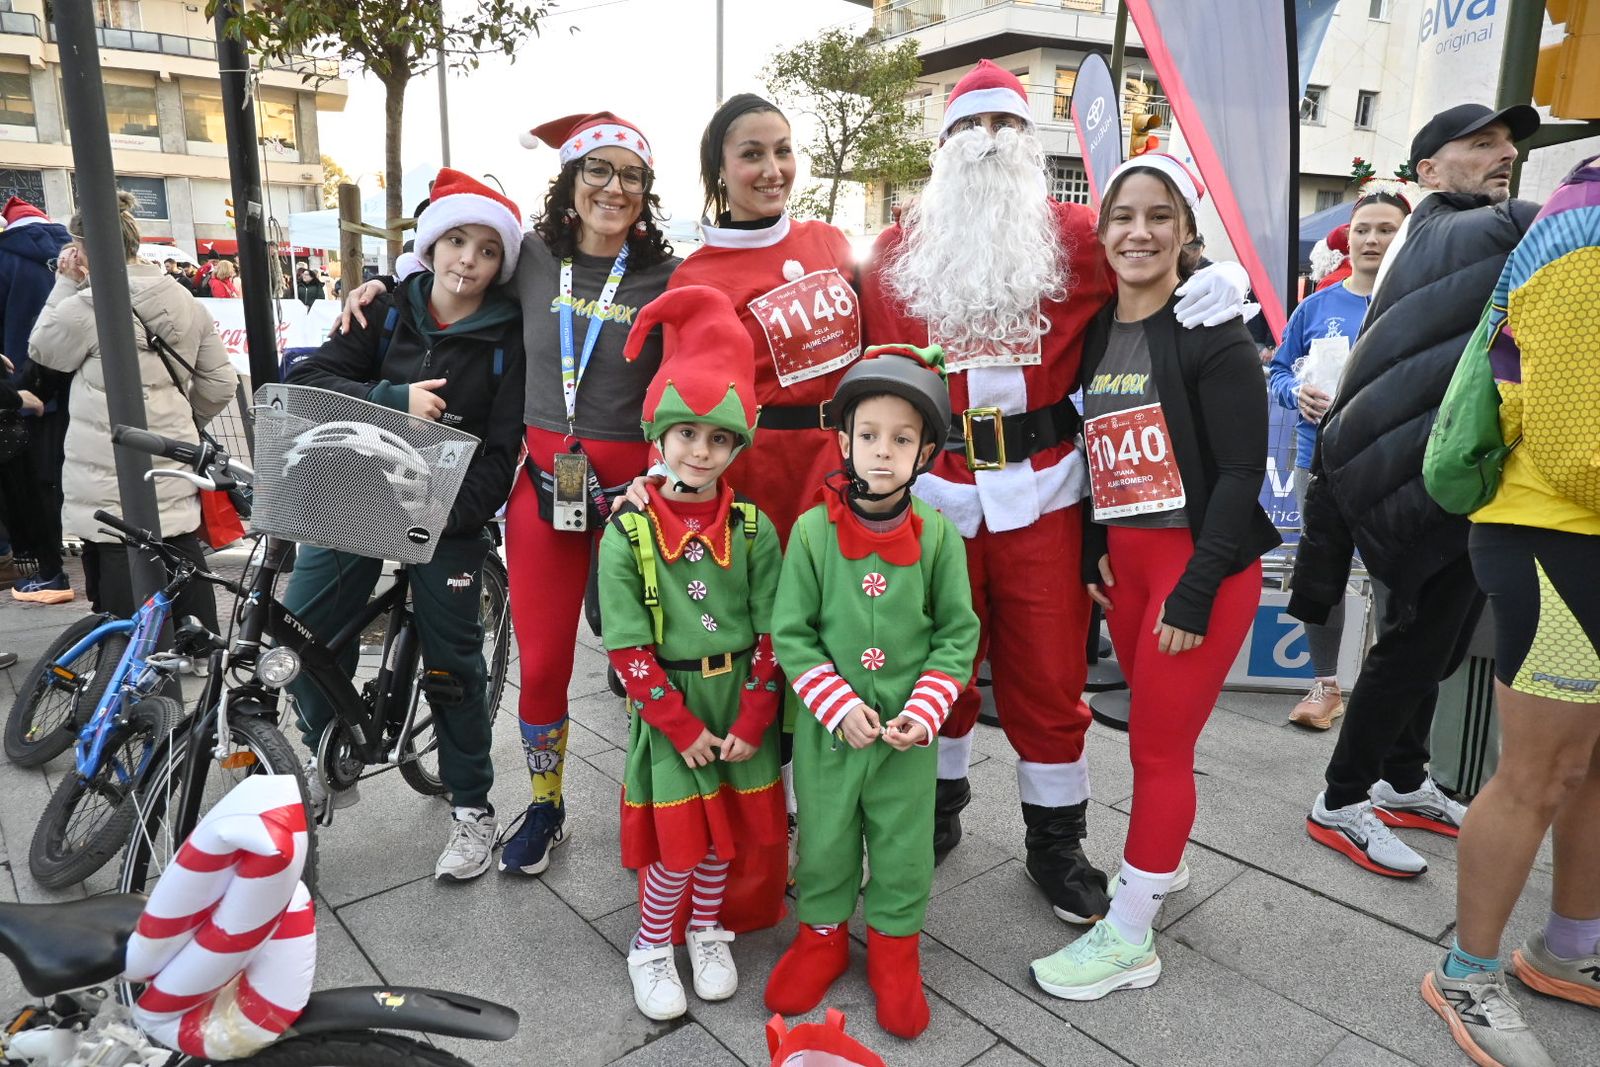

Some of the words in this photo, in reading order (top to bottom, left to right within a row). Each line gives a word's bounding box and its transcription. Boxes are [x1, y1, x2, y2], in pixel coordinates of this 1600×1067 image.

[1436, 23, 1493, 55] original
[768, 285, 853, 339] 1148
[814, 326, 830, 336] CELIA
[801, 337, 822, 351] JAIME
[1091, 425, 1166, 472] 1040
[446, 578, 470, 587] PUMA
